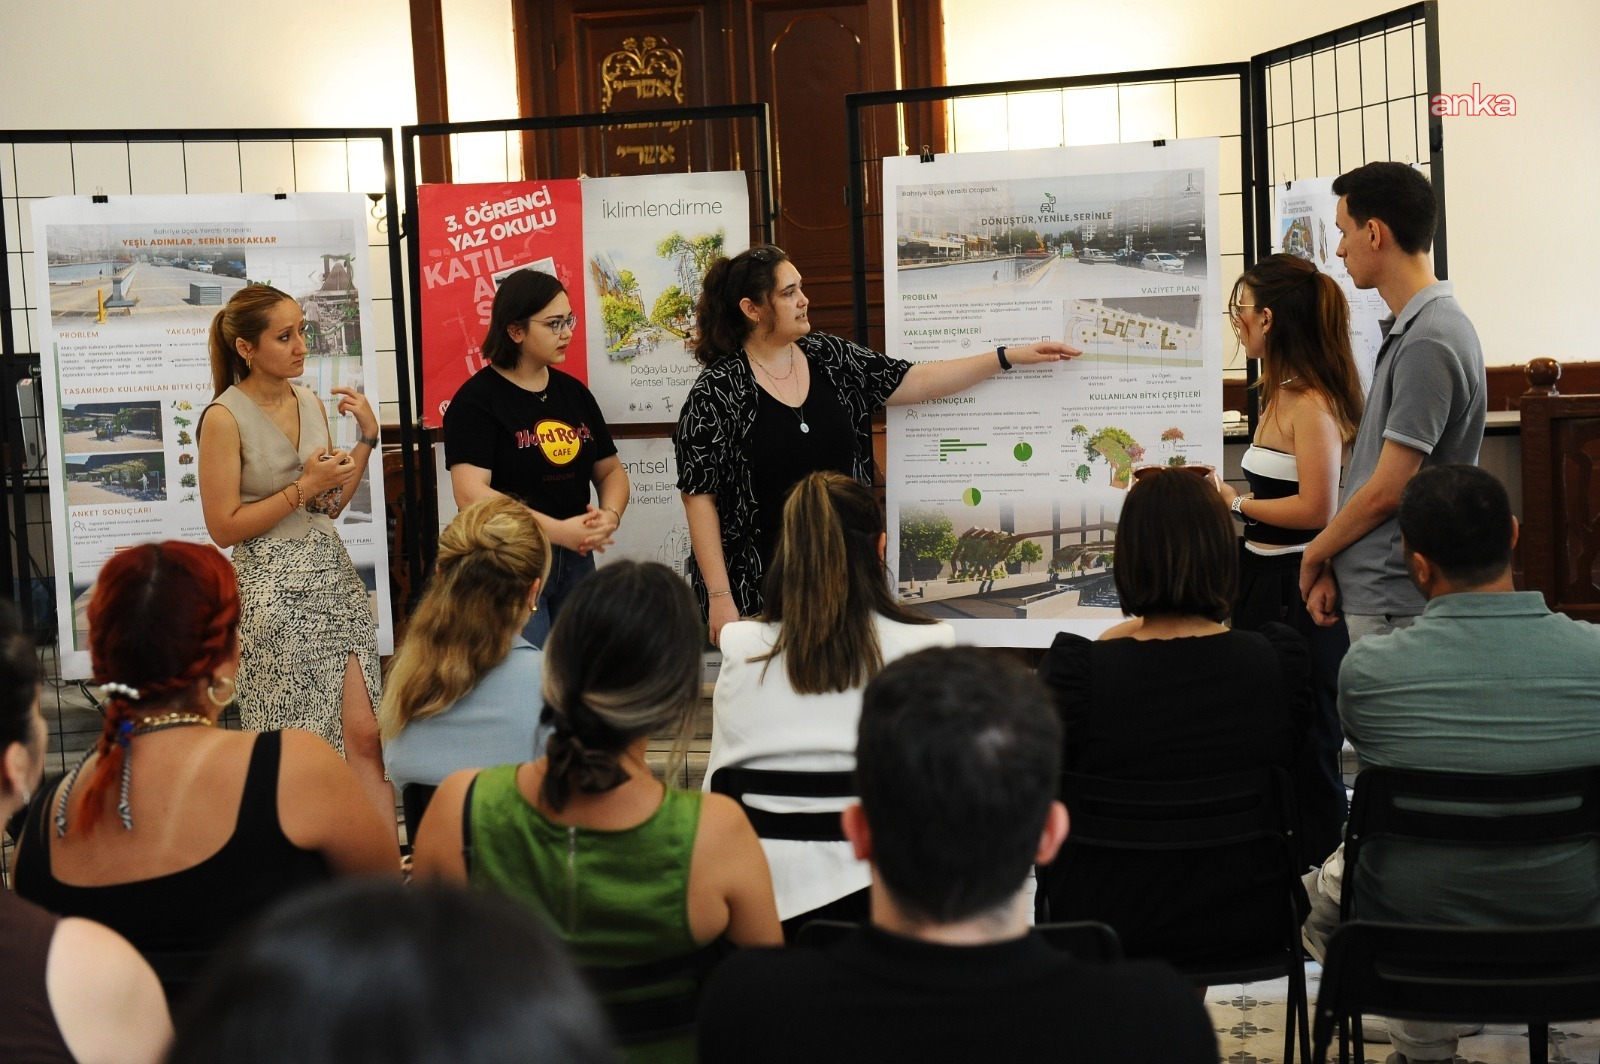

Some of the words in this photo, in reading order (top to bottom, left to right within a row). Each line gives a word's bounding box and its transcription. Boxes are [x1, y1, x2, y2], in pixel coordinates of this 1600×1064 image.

[445, 215, 462, 232] 3.
[464, 185, 552, 226] ÖĞRENCİ
[602, 198, 723, 219] İklimlendirme
[447, 227, 489, 252] YAZ
[490, 208, 557, 241] OKULU
[122, 237, 148, 248] YEŞİL
[198, 236, 225, 245] SERİN
[227, 236, 277, 245] SOKAKLAR
[423, 245, 515, 290] KATIL
[902, 293, 938, 301] PROBLEM
[166, 327, 206, 336] YAKLAŞIM
[903, 328, 942, 337] YAKLAŞIM
[631, 364, 668, 375] Doğayla
[631, 377, 664, 387] Kentsel
[64, 386, 115, 395] TASARIMDA
[118, 384, 169, 393] KULLANILAN
[1089, 393, 1138, 401] KULLANILAN
[1140, 391, 1160, 400] BİTKİ
[1162, 390, 1201, 400] ÇEŞİTLERİ
[931, 397, 976, 406] SONUÇLARI
[515, 428, 556, 448] Hard
[556, 422, 594, 444] Rock
[552, 447, 572, 457] CAFE
[621, 457, 669, 474] entsel
[633, 482, 654, 492] Yapı
[637, 494, 673, 504] Kentler!
[102, 507, 152, 516] SONUÇLARI
